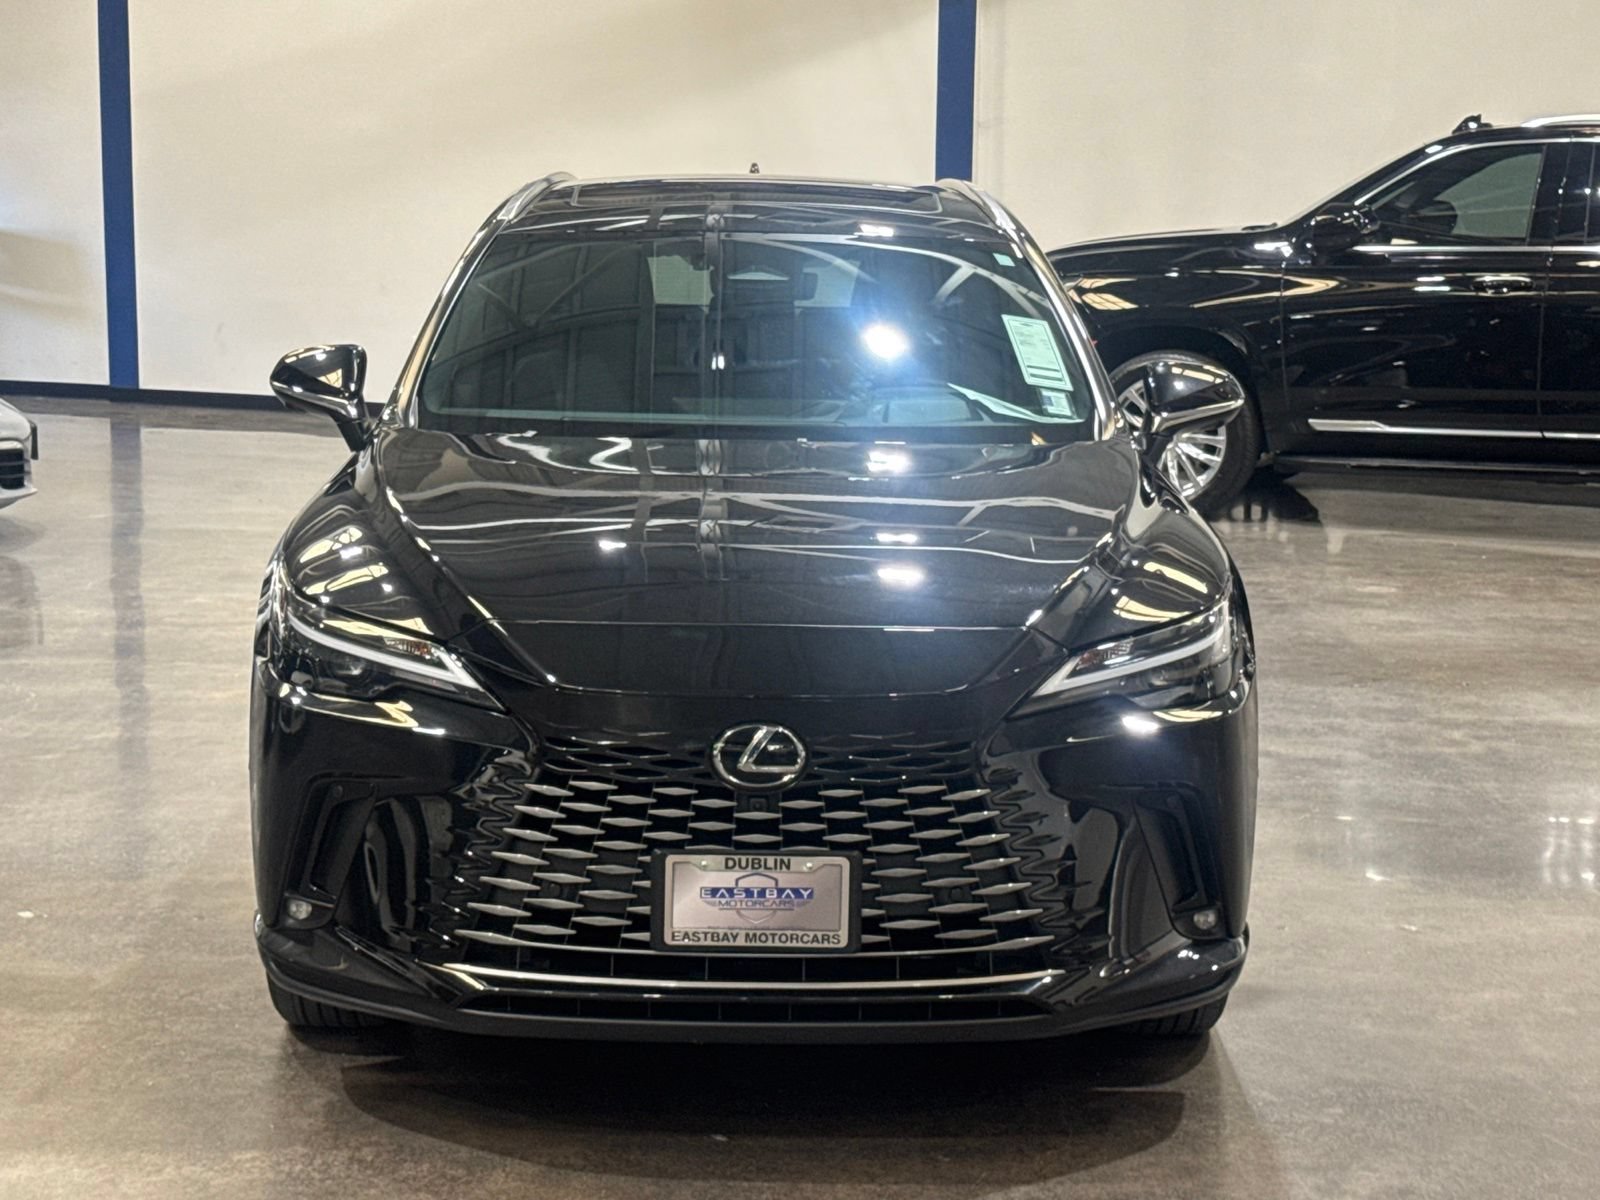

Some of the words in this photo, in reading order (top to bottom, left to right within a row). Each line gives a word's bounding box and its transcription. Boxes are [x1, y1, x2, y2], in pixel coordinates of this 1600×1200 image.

[724, 857, 791, 870] DUBLIN
[701, 888, 813, 899] EASTBAY
[718, 899, 794, 907] MOTORCARS
[671, 930, 740, 944] EASTBAY
[744, 932, 841, 945] MOTORCARS
